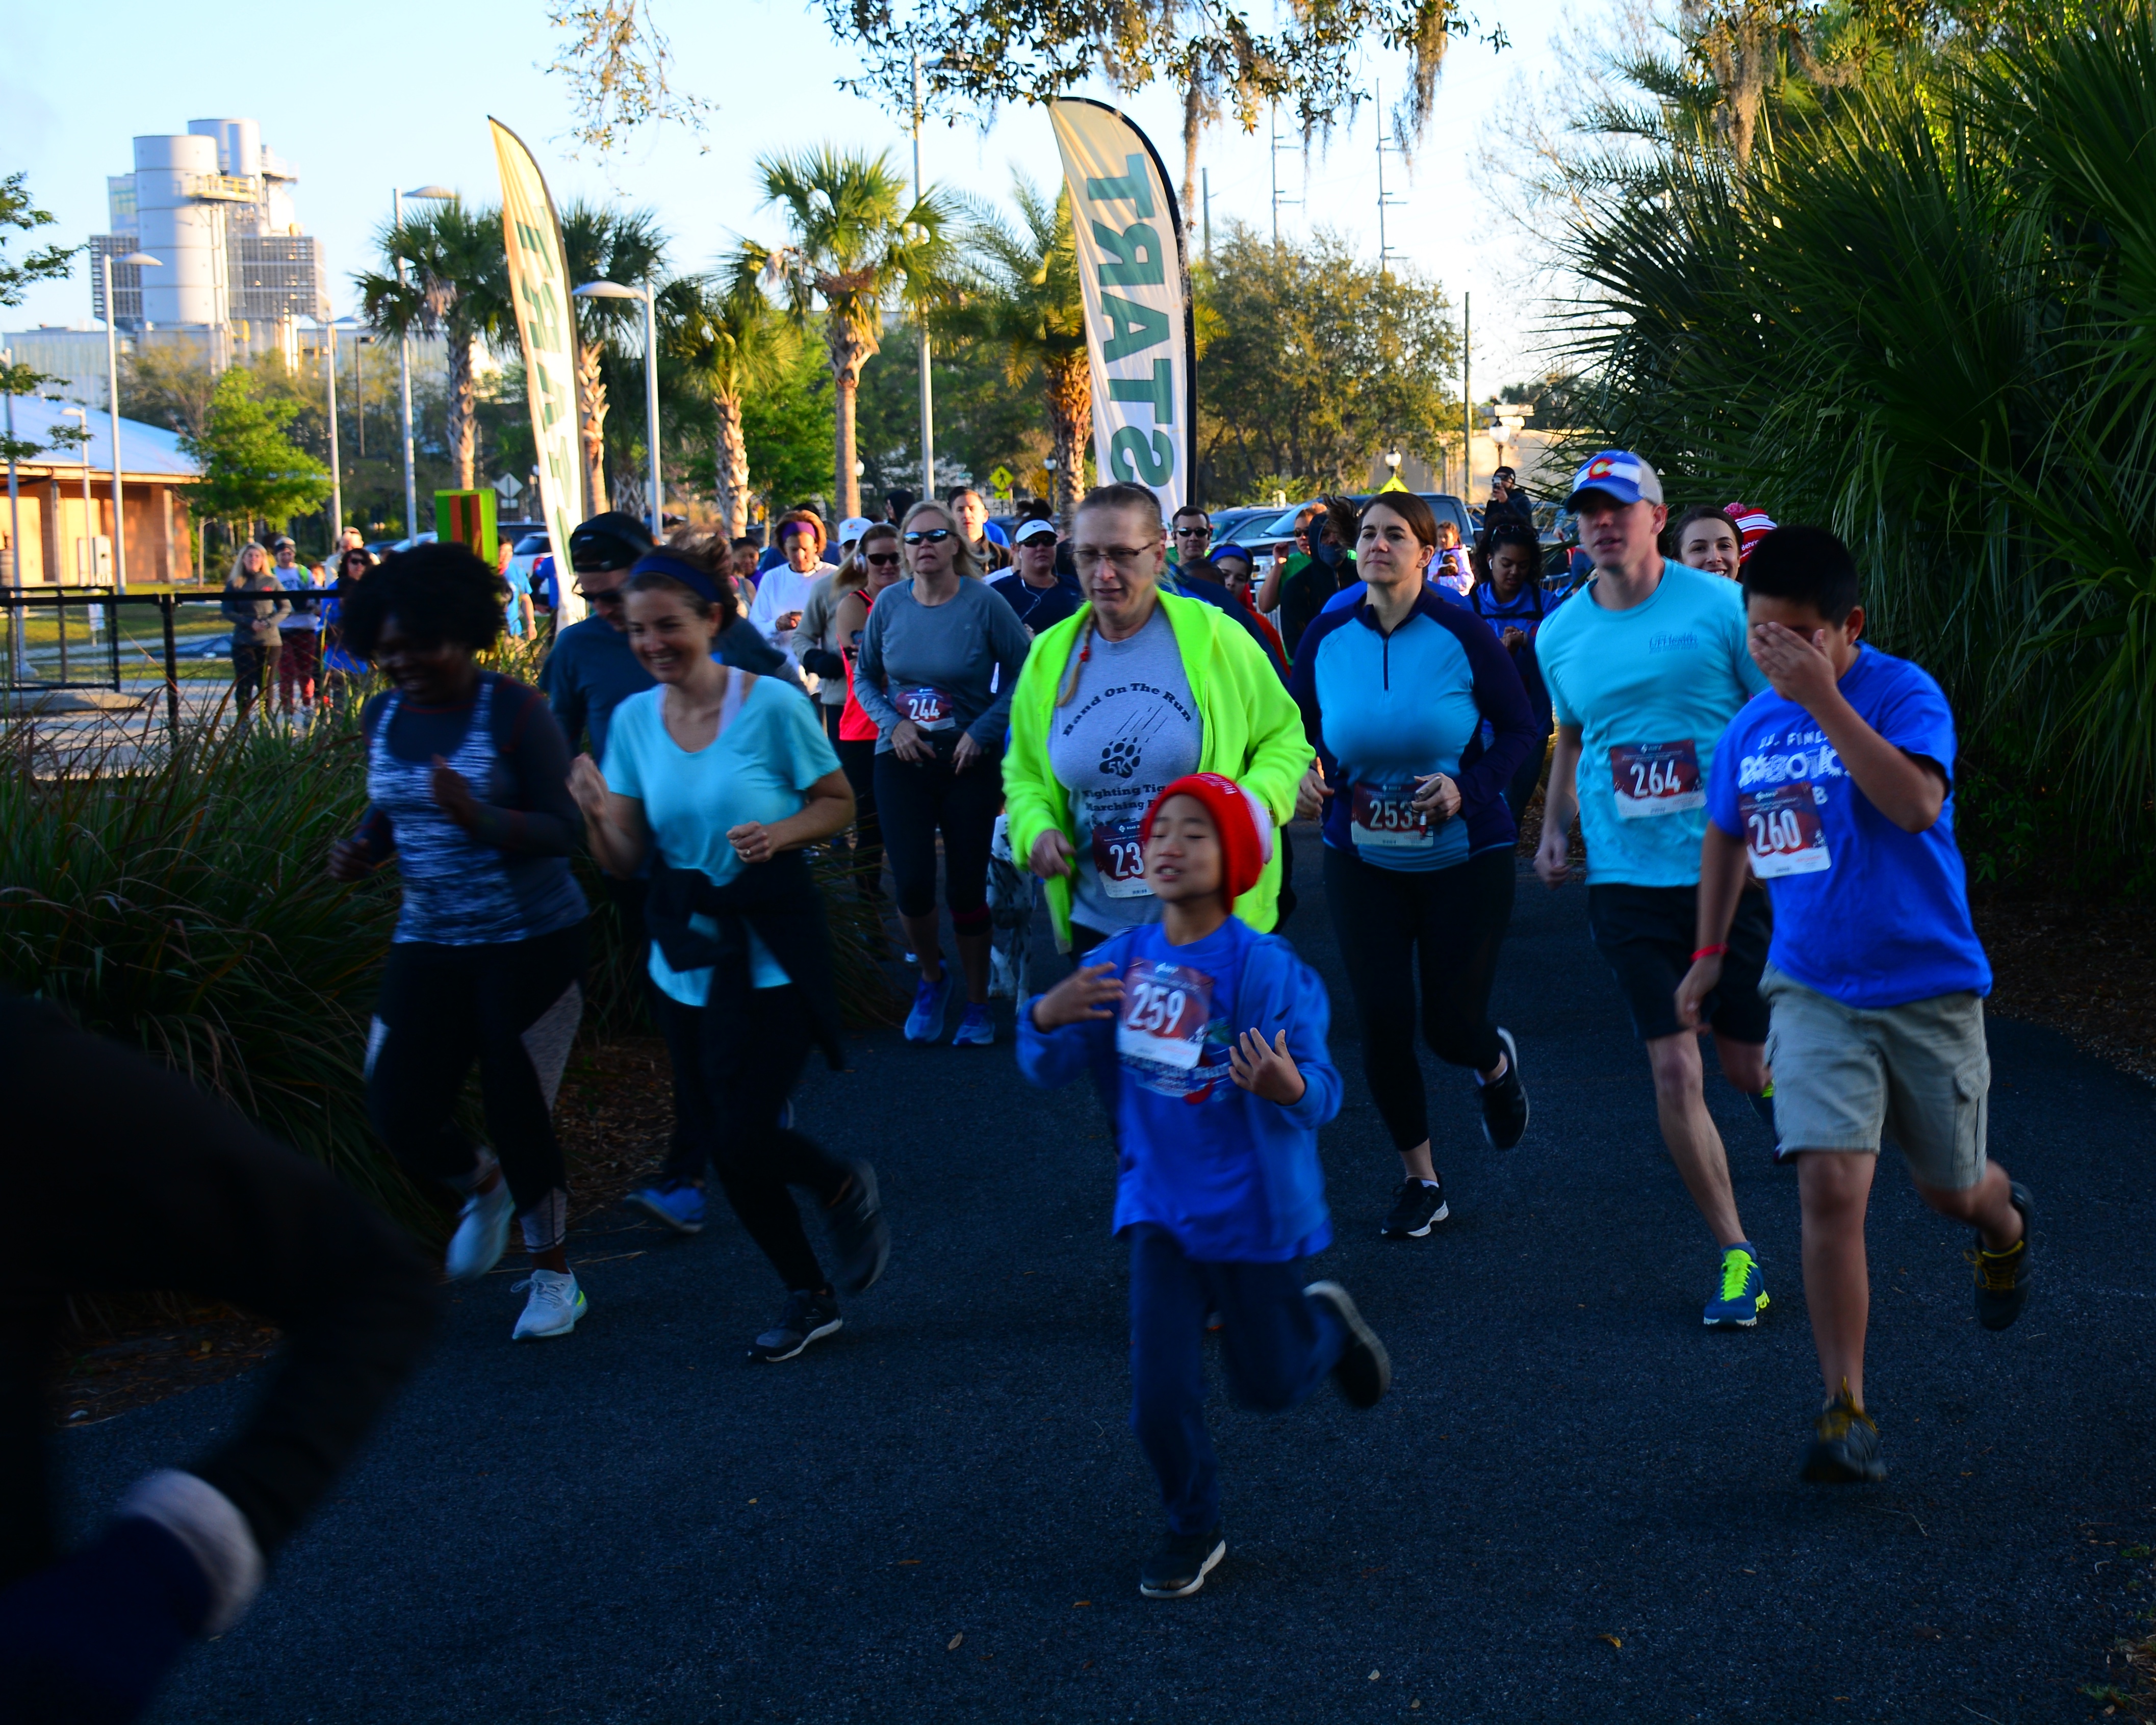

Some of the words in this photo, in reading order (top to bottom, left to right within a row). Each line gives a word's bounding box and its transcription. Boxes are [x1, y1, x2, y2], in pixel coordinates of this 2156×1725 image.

[1741, 539, 1760, 551] Behrin
[908, 699, 940, 720] 244
[1105, 686, 1127, 698] On
[1130, 683, 1160, 694] The
[1163, 691, 1191, 722] Run
[1786, 730, 1829, 746] FINL
[1108, 761, 1130, 774] 5K
[1630, 759, 1682, 797] 264
[1143, 784, 1166, 794] Tig
[1370, 799, 1413, 829] 253
[1748, 809, 1802, 853] 260
[1110, 842, 1145, 877] 23
[1126, 982, 1187, 1035] 259
